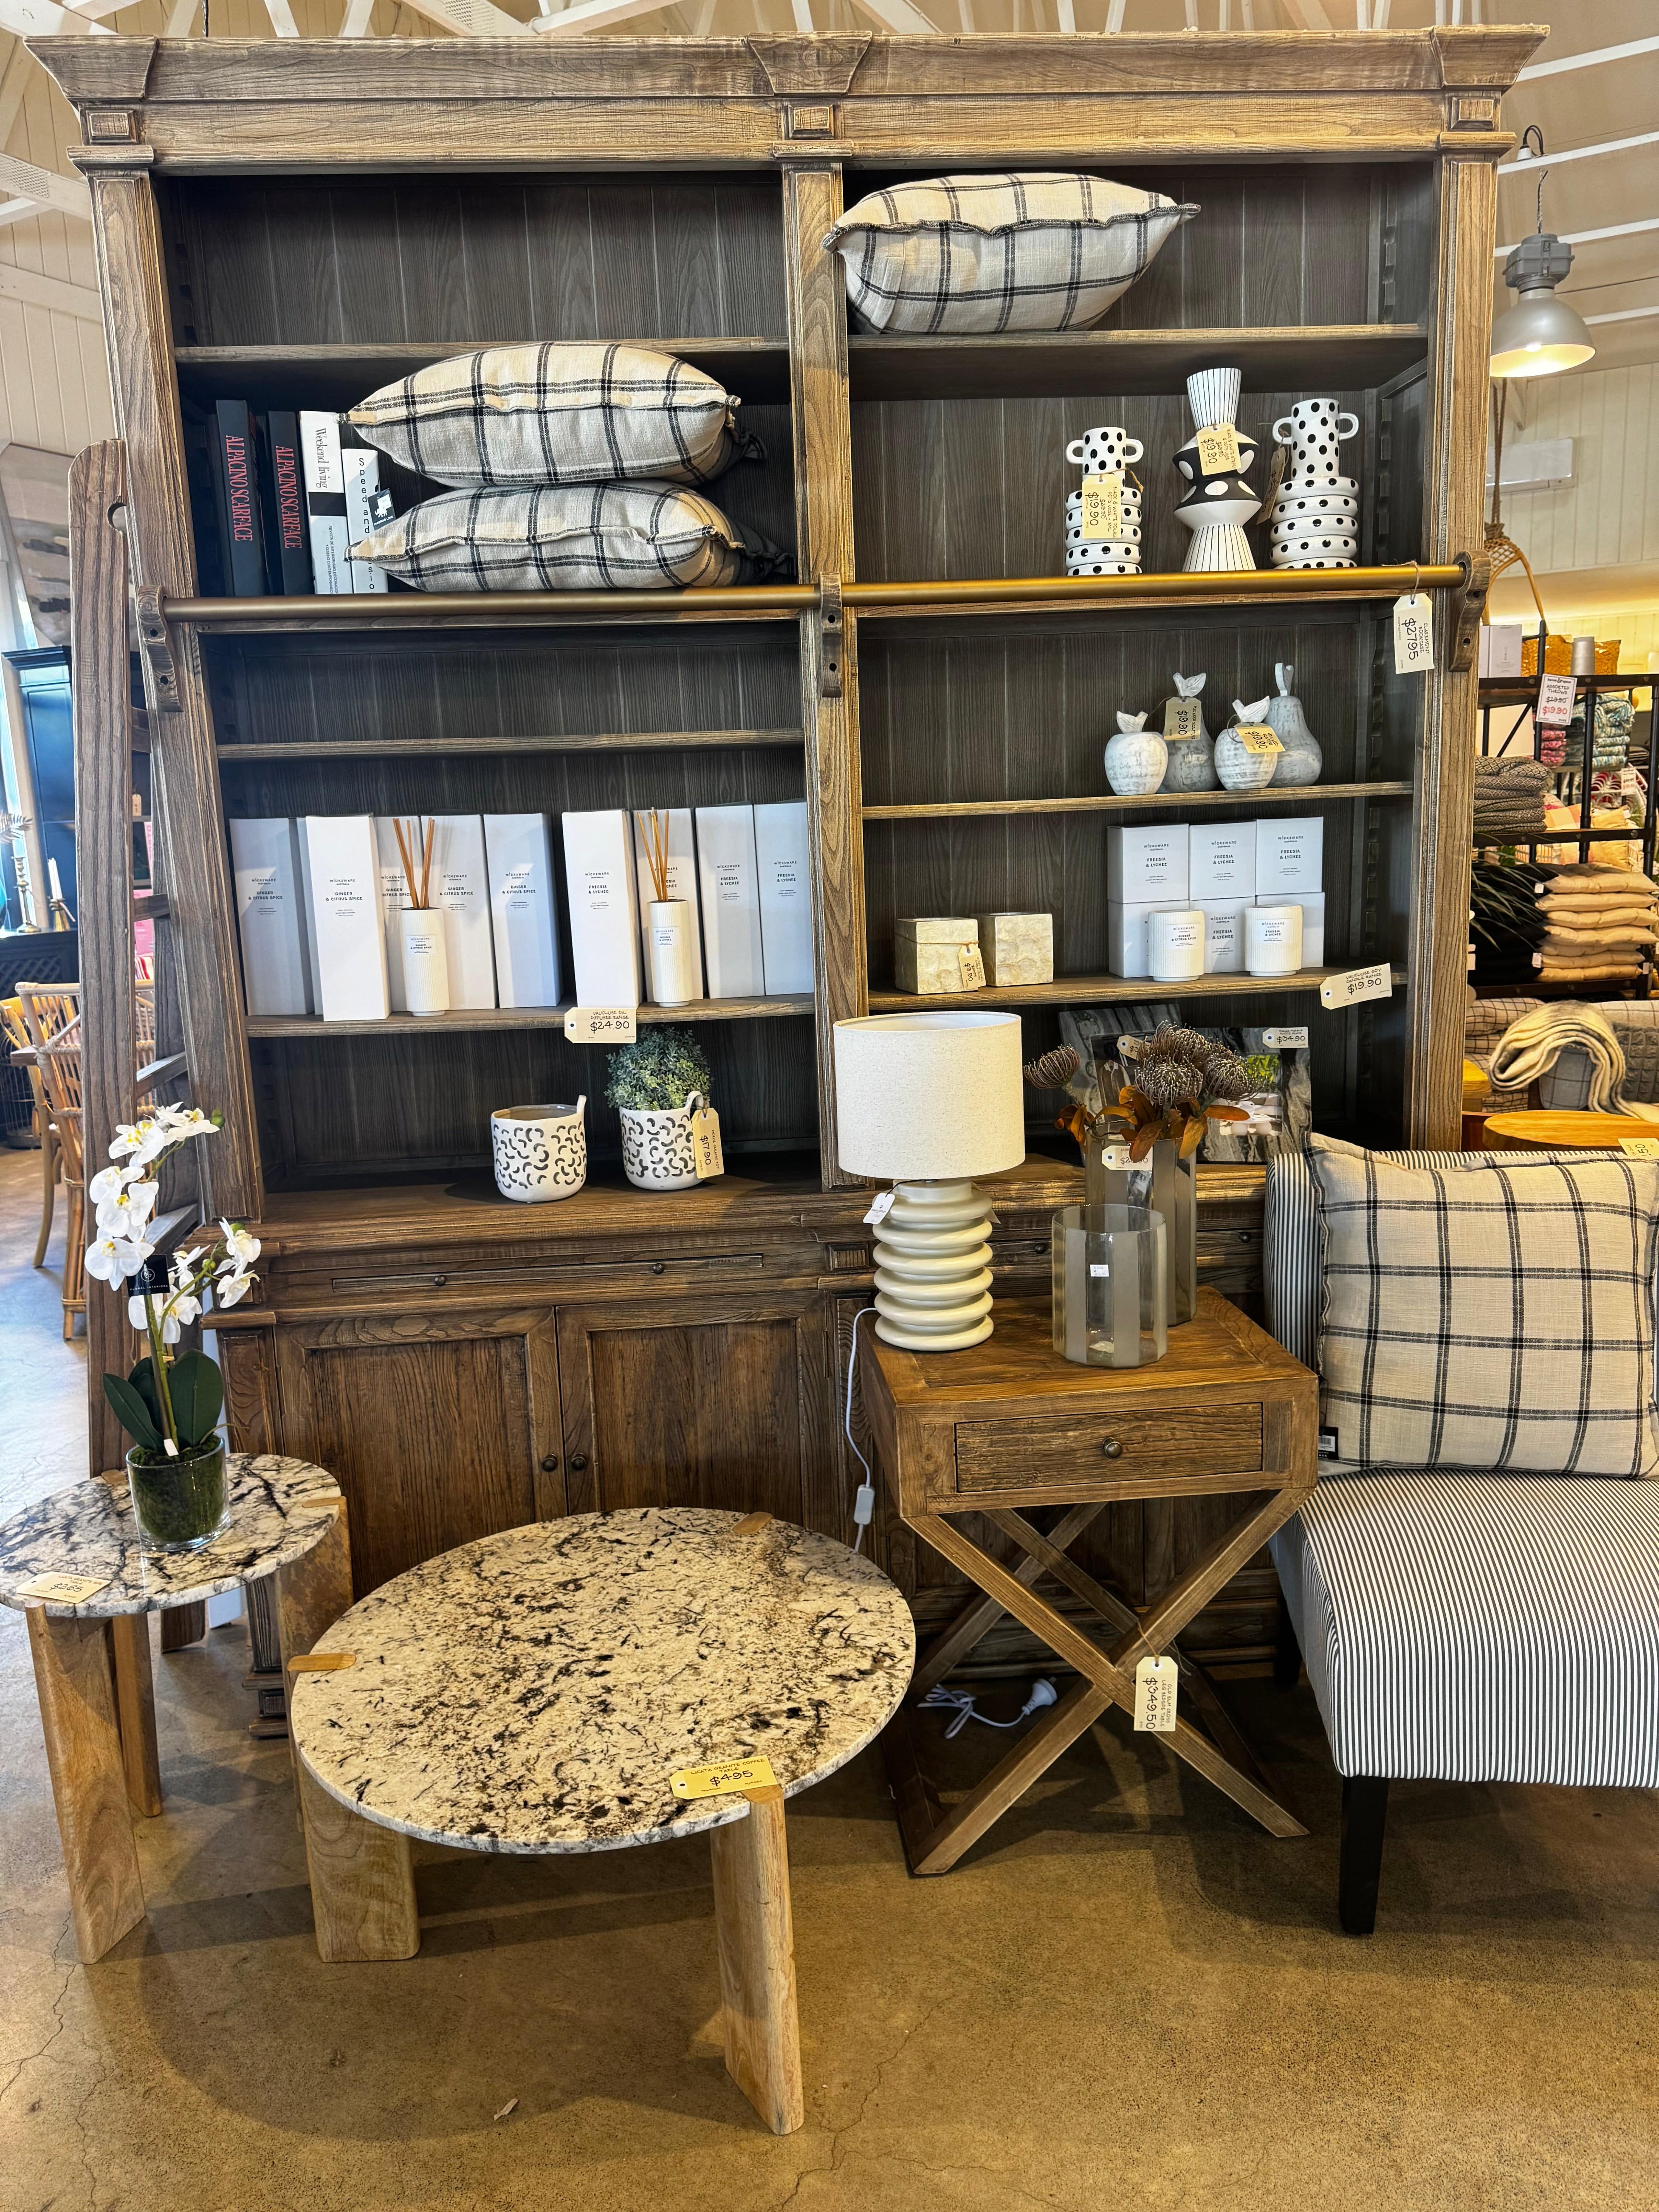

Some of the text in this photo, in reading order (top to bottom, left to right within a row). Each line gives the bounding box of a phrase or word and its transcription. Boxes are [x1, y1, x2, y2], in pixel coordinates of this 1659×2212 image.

[315, 428, 330, 488] Weekend living
[1200, 438, 1218, 464] $19.90
[230, 489, 253, 541] SCARFACE
[1085, 492, 1099, 526] $19.90
[280, 498, 302, 549] SCARFACE
[1401, 618, 1419, 660] $2795
[1174, 710, 1189, 735] $19.90
[1347, 978, 1382, 995] $19.90
[590, 1021, 630, 1034] $24.90
[1277, 1036, 1305, 1044] $34.90
[699, 1135, 711, 1165] $17.90
[49, 1583, 84, 1592] $265
[1142, 1676, 1158, 1730] $349.50
[709, 1770, 753, 1787] $495
